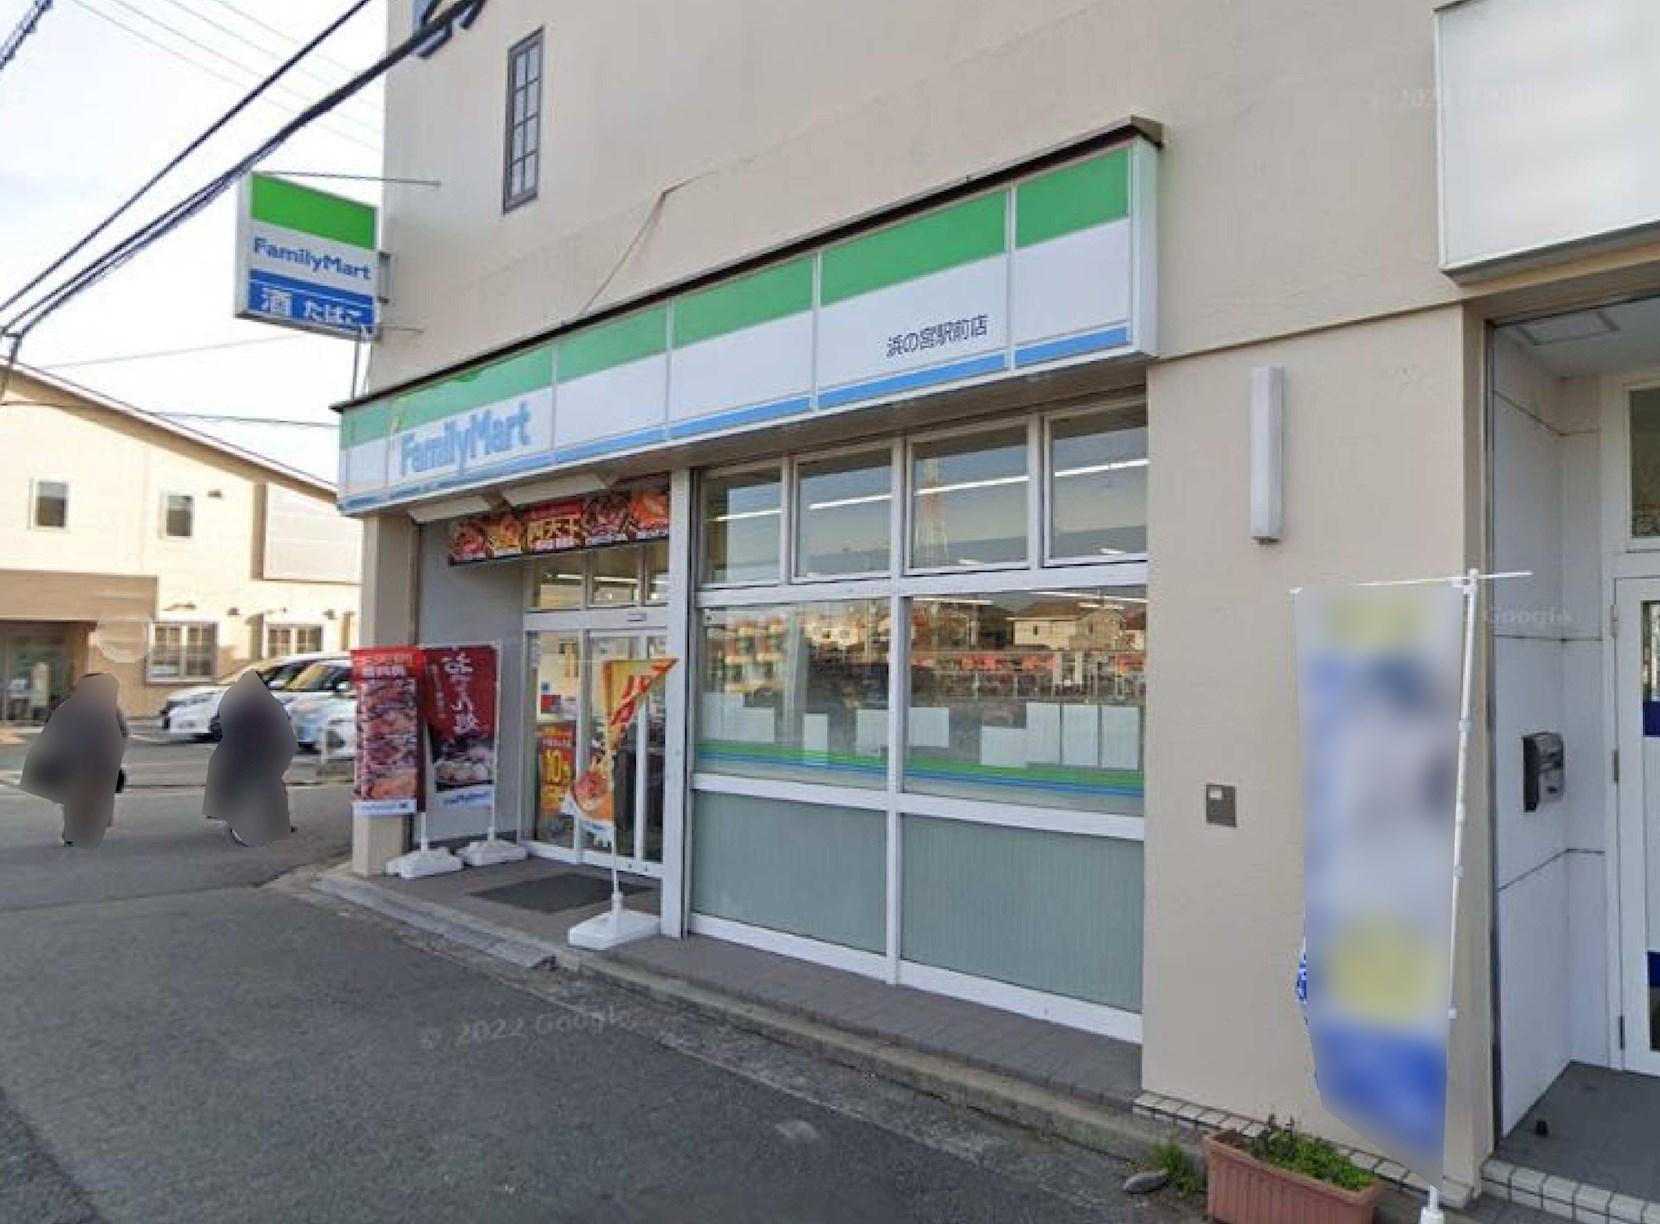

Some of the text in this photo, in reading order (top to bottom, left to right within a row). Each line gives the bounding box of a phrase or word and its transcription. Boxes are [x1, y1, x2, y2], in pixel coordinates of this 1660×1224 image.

[254, 236, 371, 281] FamilyMart
[261, 286, 363, 325] 酒 たばこ
[886, 313, 988, 358] 浜の宮駅前店
[400, 401, 531, 476] FamilyMart
